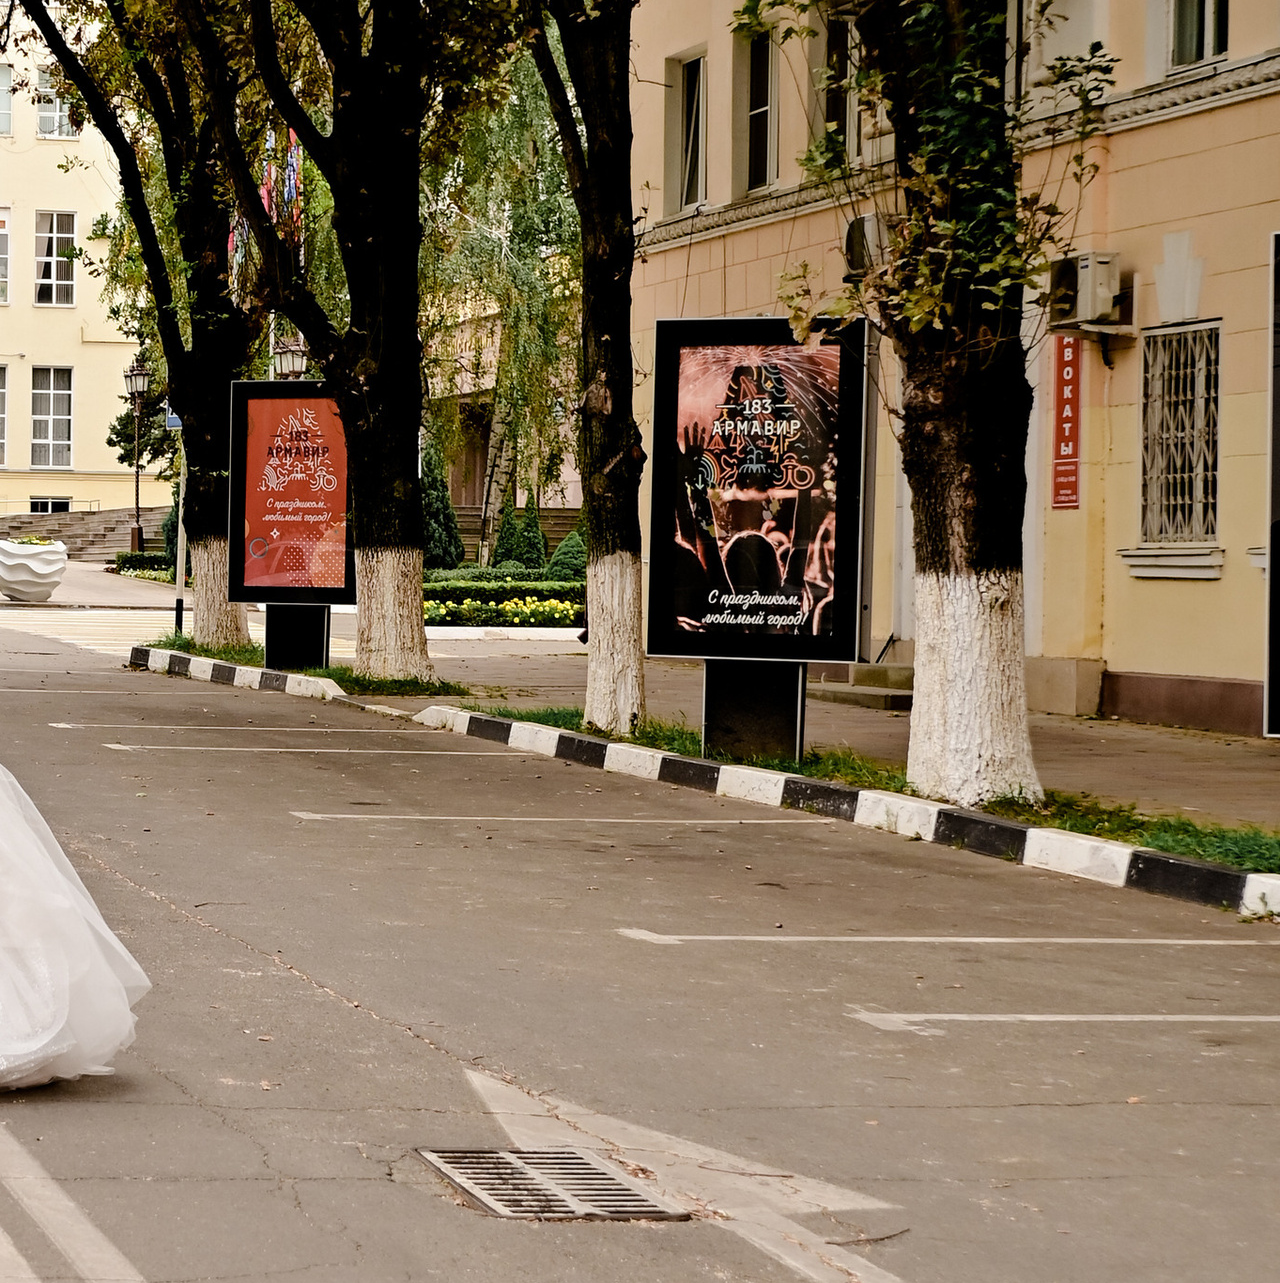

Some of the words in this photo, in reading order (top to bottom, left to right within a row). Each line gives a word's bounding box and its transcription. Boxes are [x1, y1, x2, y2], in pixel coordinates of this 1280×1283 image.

[743, 399, 772, 414] 183
[712, 420, 800, 436] АРМАВИР
[289, 430, 309, 442] 183
[267, 446, 330, 458] АРМАВИР
[266, 498, 274, 508] С
[262, 511, 303, 522] любимый
[303, 511, 332, 524] город!
[708, 589, 719, 604] С
[701, 609, 765, 624] любимый
[766, 611, 809, 629] город!
